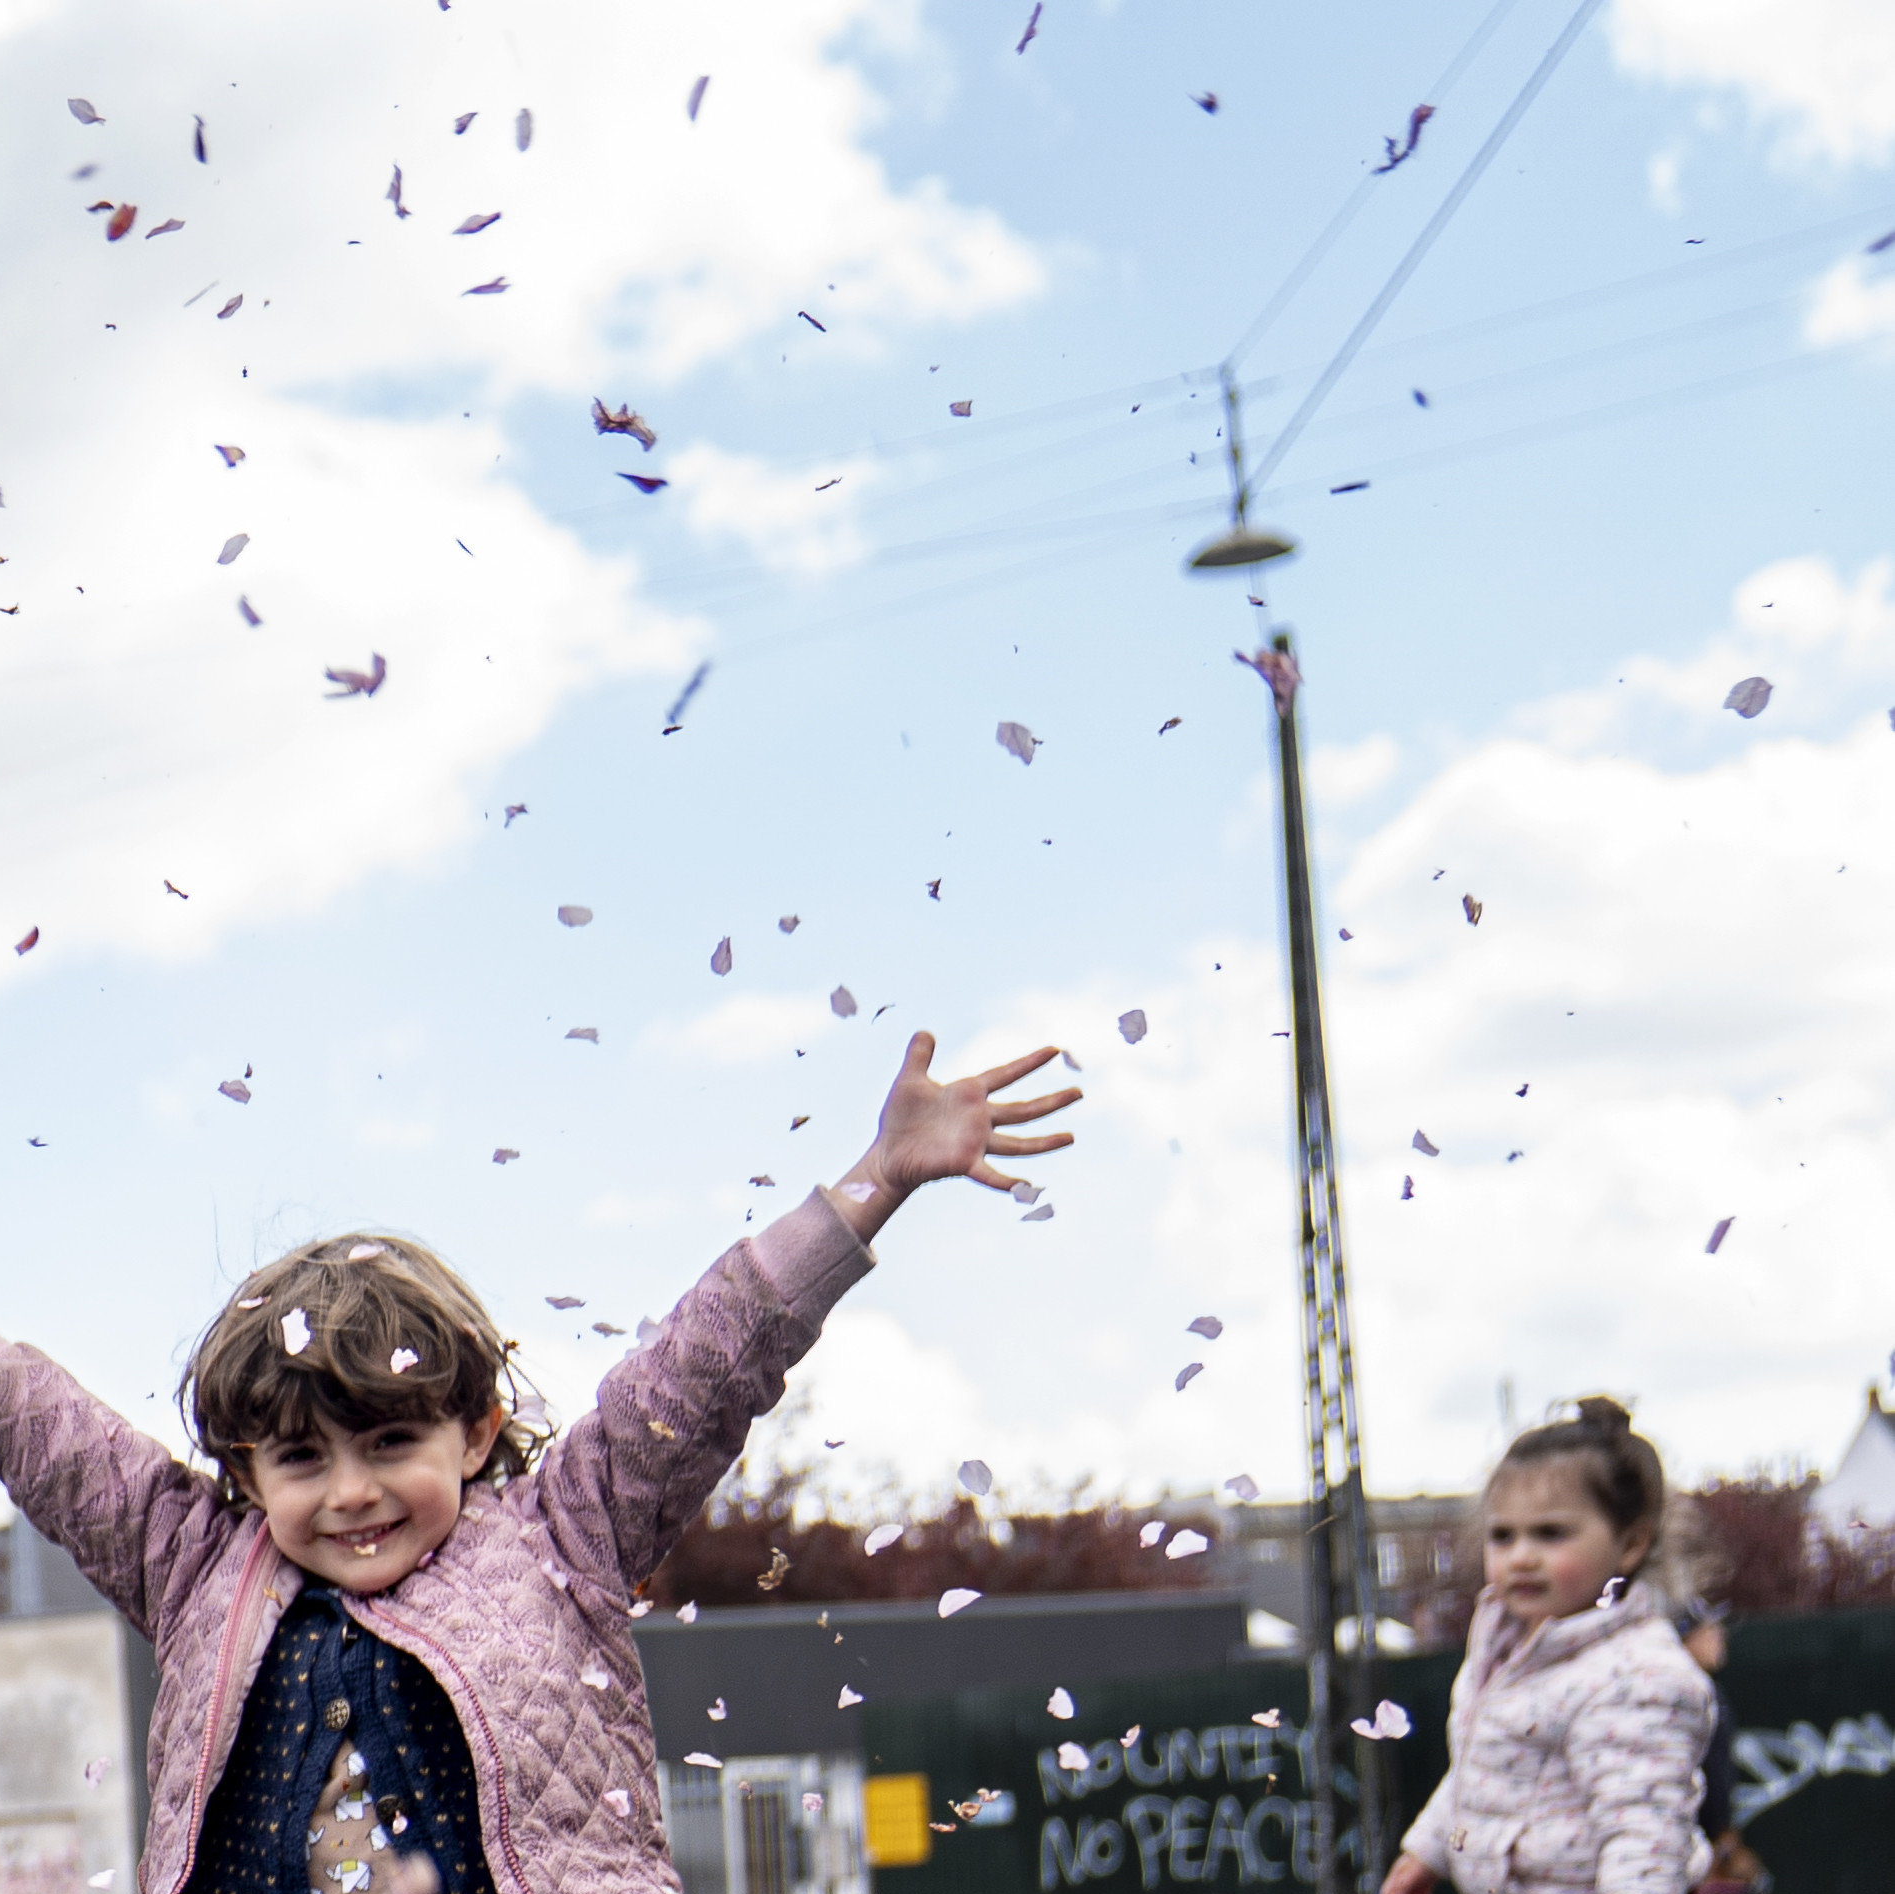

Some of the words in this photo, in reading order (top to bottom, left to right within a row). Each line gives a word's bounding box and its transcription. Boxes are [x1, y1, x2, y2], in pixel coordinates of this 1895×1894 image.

[1037, 1738, 1124, 1806] NO
[1039, 1815, 1125, 1892] NO
[1122, 1794, 1324, 1890] PEACE
